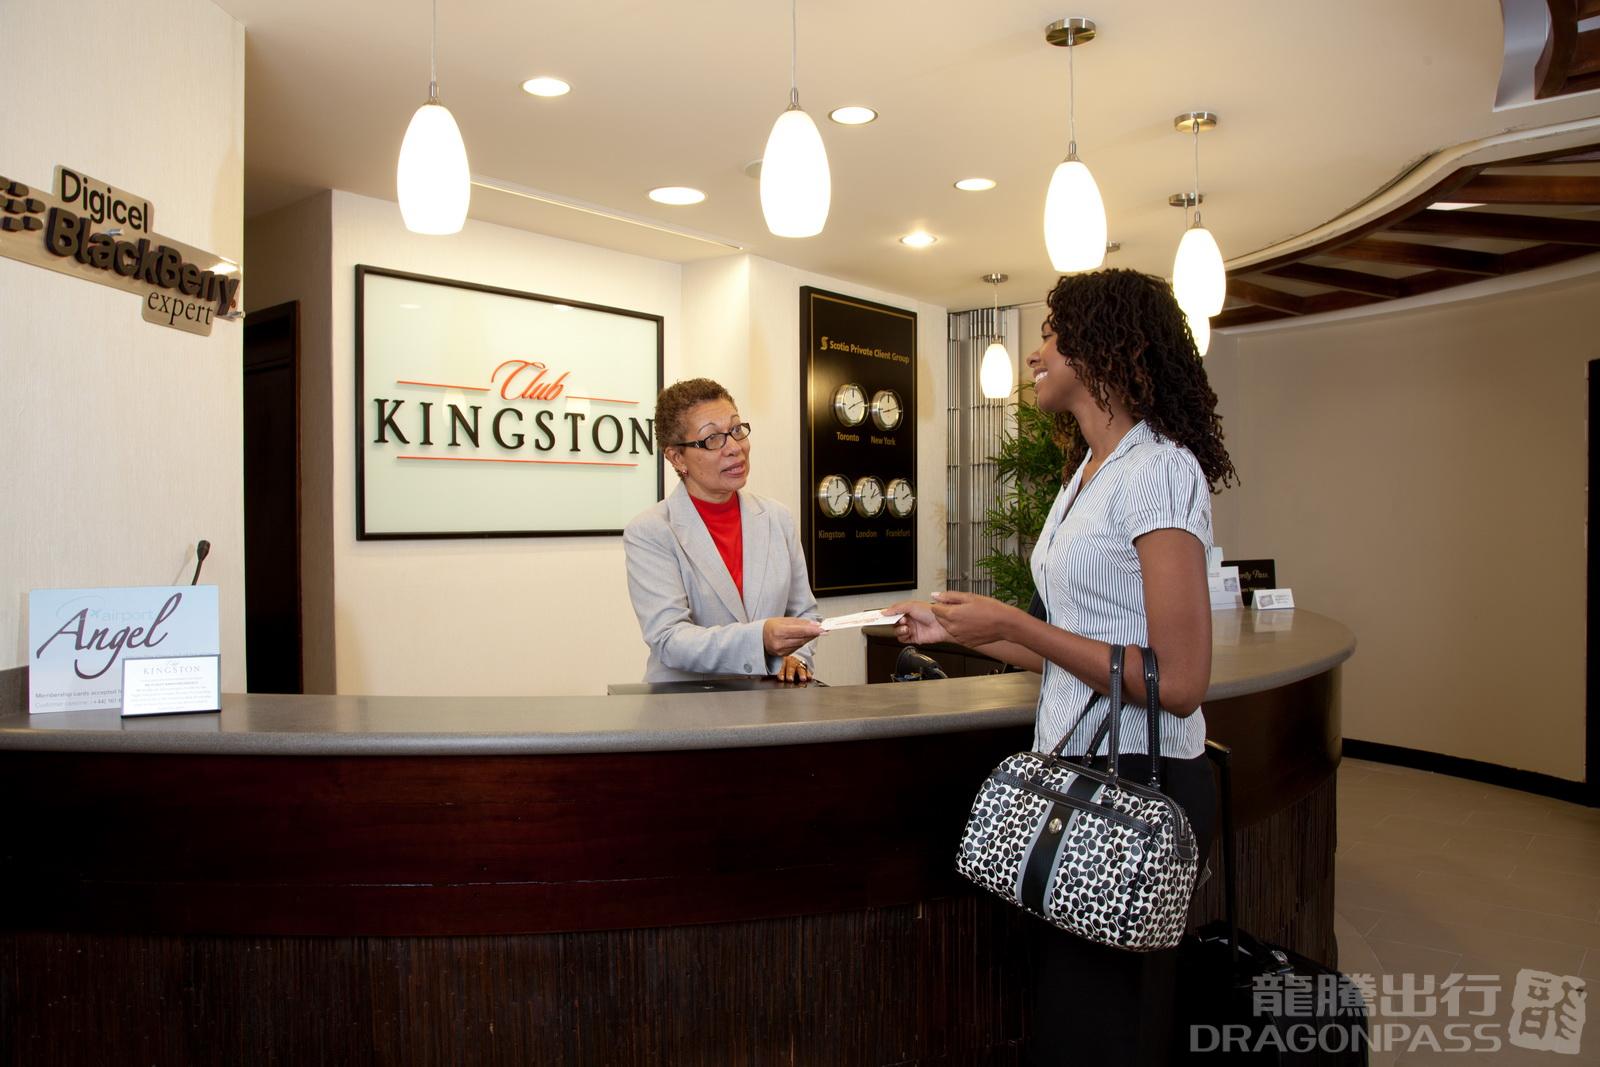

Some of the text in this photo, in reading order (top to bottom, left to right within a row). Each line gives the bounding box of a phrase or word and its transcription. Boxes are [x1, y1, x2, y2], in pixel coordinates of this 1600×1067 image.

[61, 168, 148, 233] Digicel
[46, 207, 240, 316] BlackBerry
[147, 291, 213, 325] expert
[829, 340, 909, 364] Scotia Private Client Group
[491, 360, 571, 401] Club
[373, 398, 656, 455] KINGSTON
[836, 431, 860, 442] Toronto
[870, 435, 896, 446] New York
[818, 529, 846, 541] Kingston
[855, 530, 878, 538] London
[885, 529, 911, 538] Frankfurt
[36, 592, 182, 680] Angel
[143, 664, 201, 676] KINGSTON
